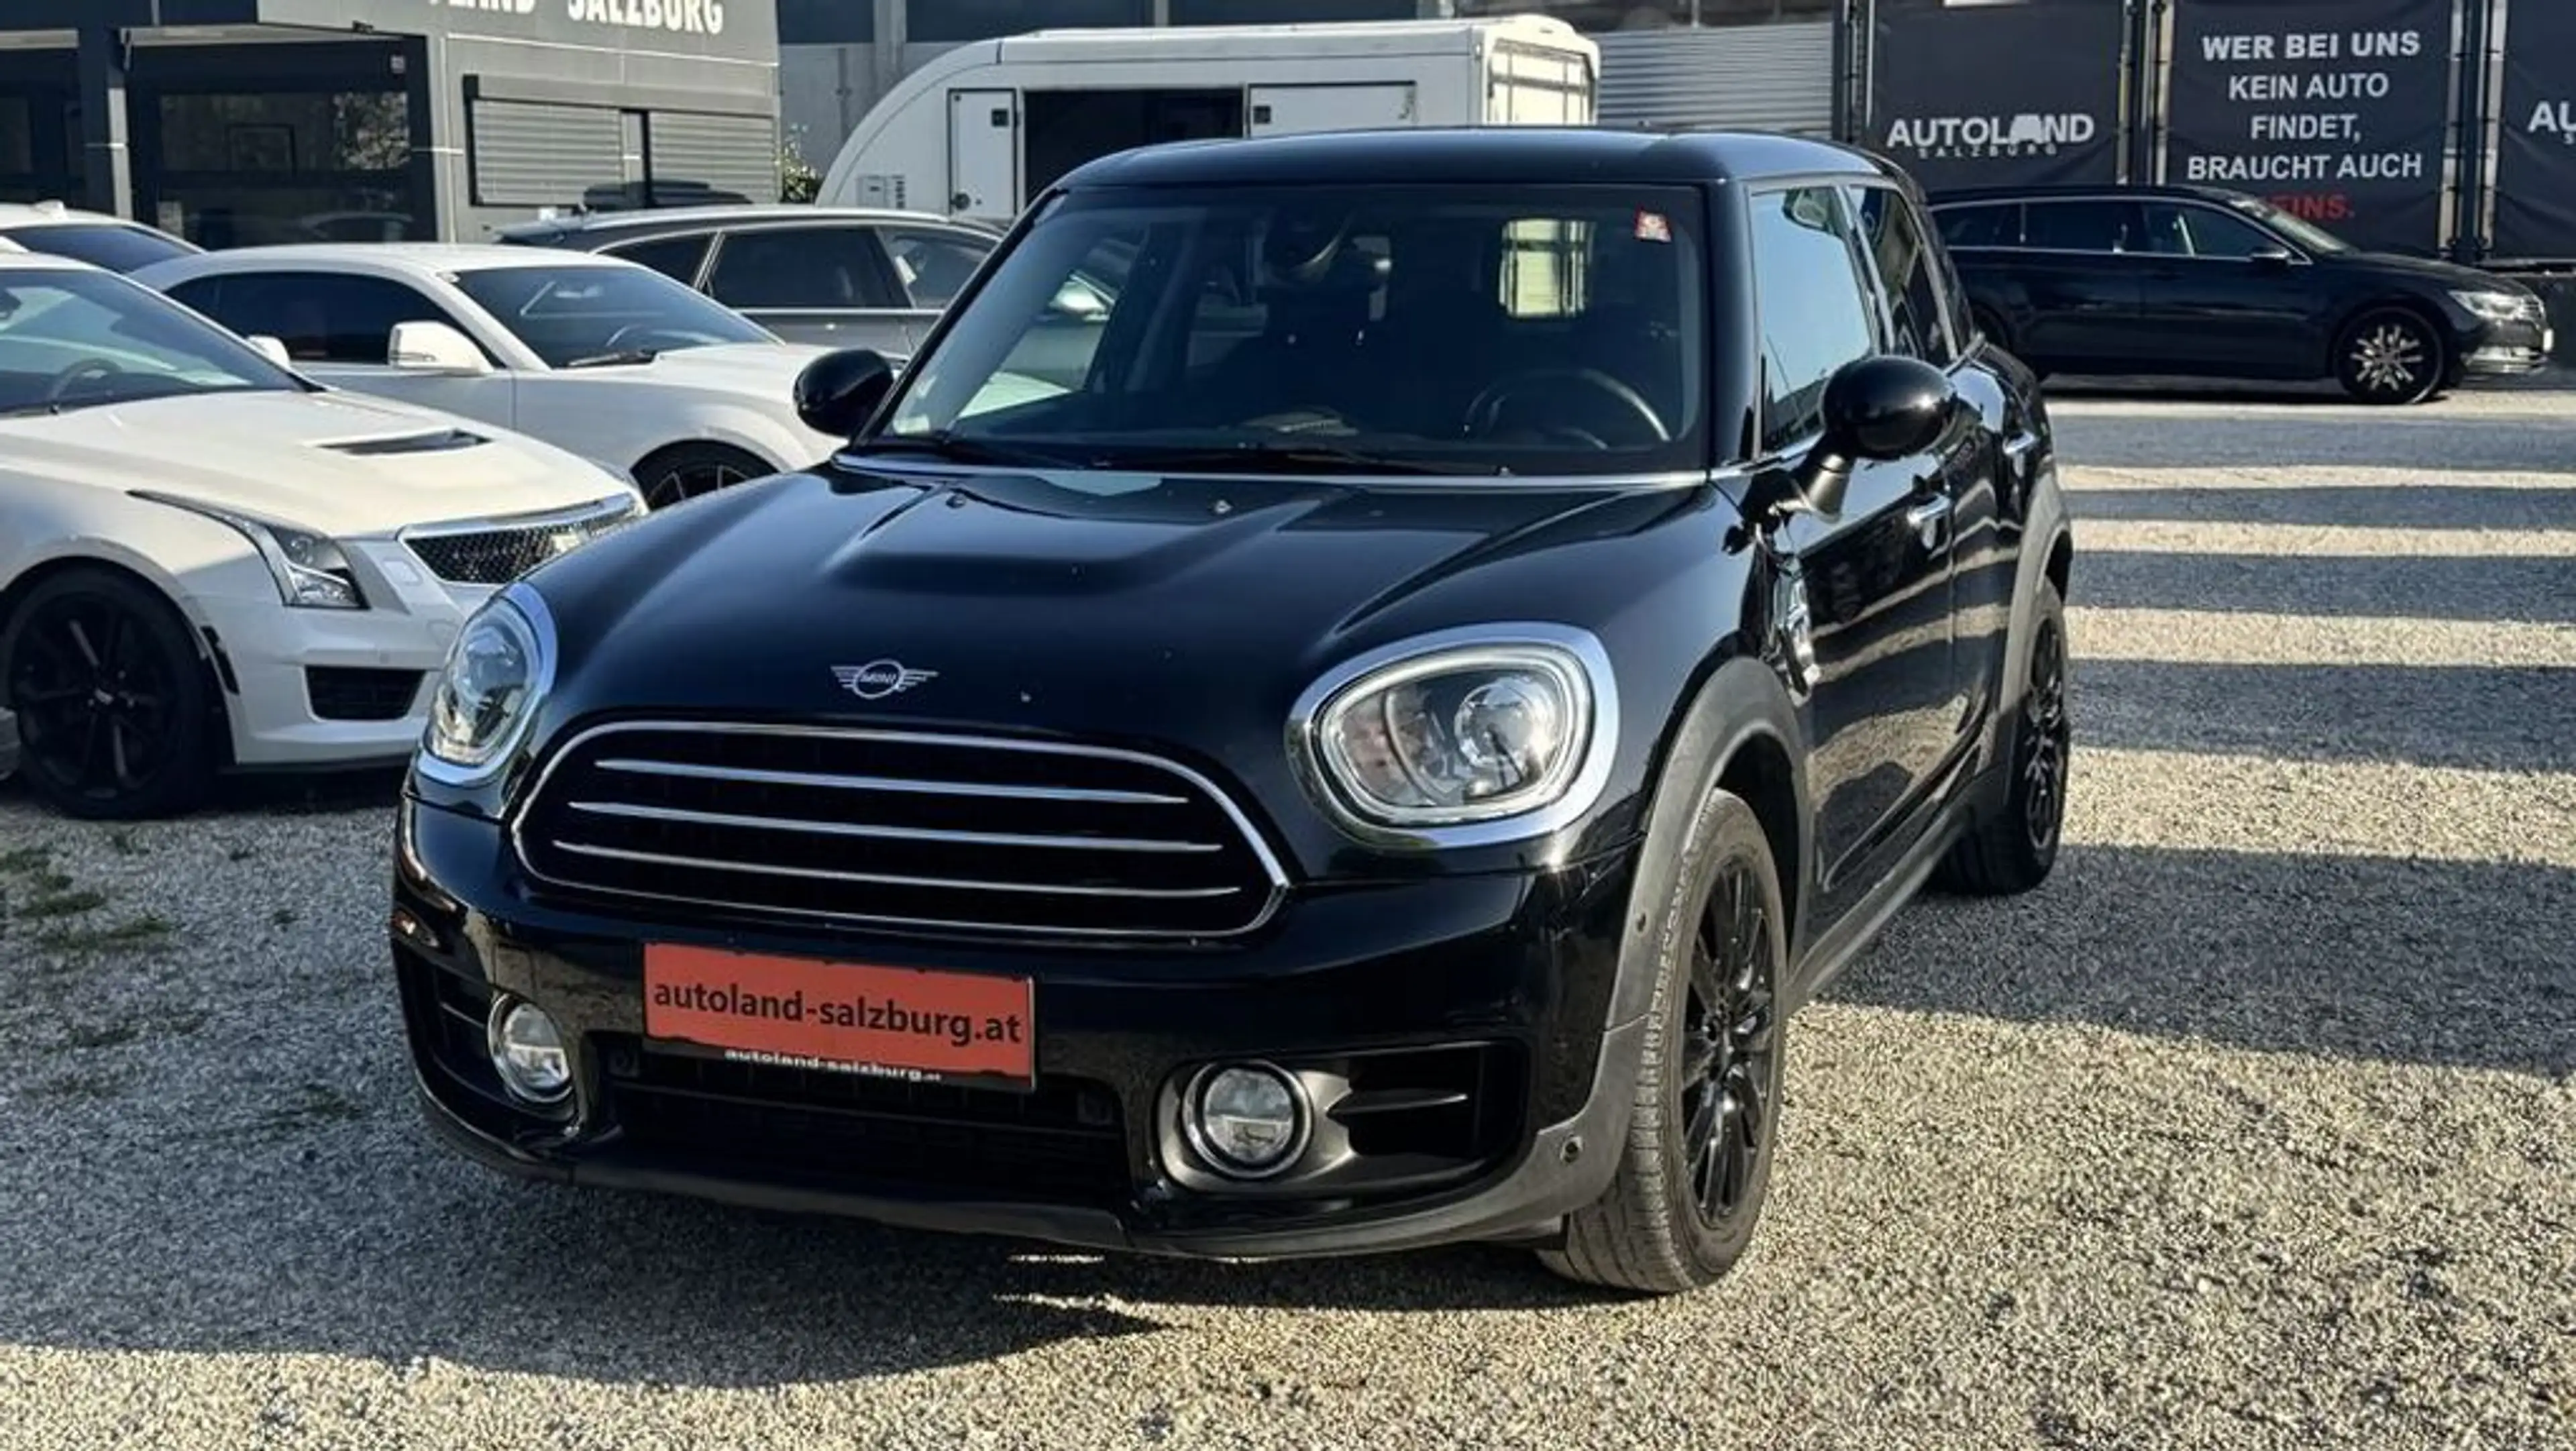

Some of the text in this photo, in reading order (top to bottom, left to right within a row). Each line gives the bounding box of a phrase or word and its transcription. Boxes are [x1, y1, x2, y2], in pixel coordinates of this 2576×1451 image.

[2202, 32, 2421, 60] WER BEI UNS
[2229, 72, 2390, 100] KEIN AUTO
[2251, 113, 2361, 144] FINDET,
[1918, 142, 2057, 160] SALZBURG
[2187, 153, 2422, 180] BRAUCHT AUCH
[2269, 193, 2356, 219] EINS.
[653, 982, 1021, 1047] autoland-salzburg.at
[724, 1048, 943, 1082] autoland-salzburg.at
